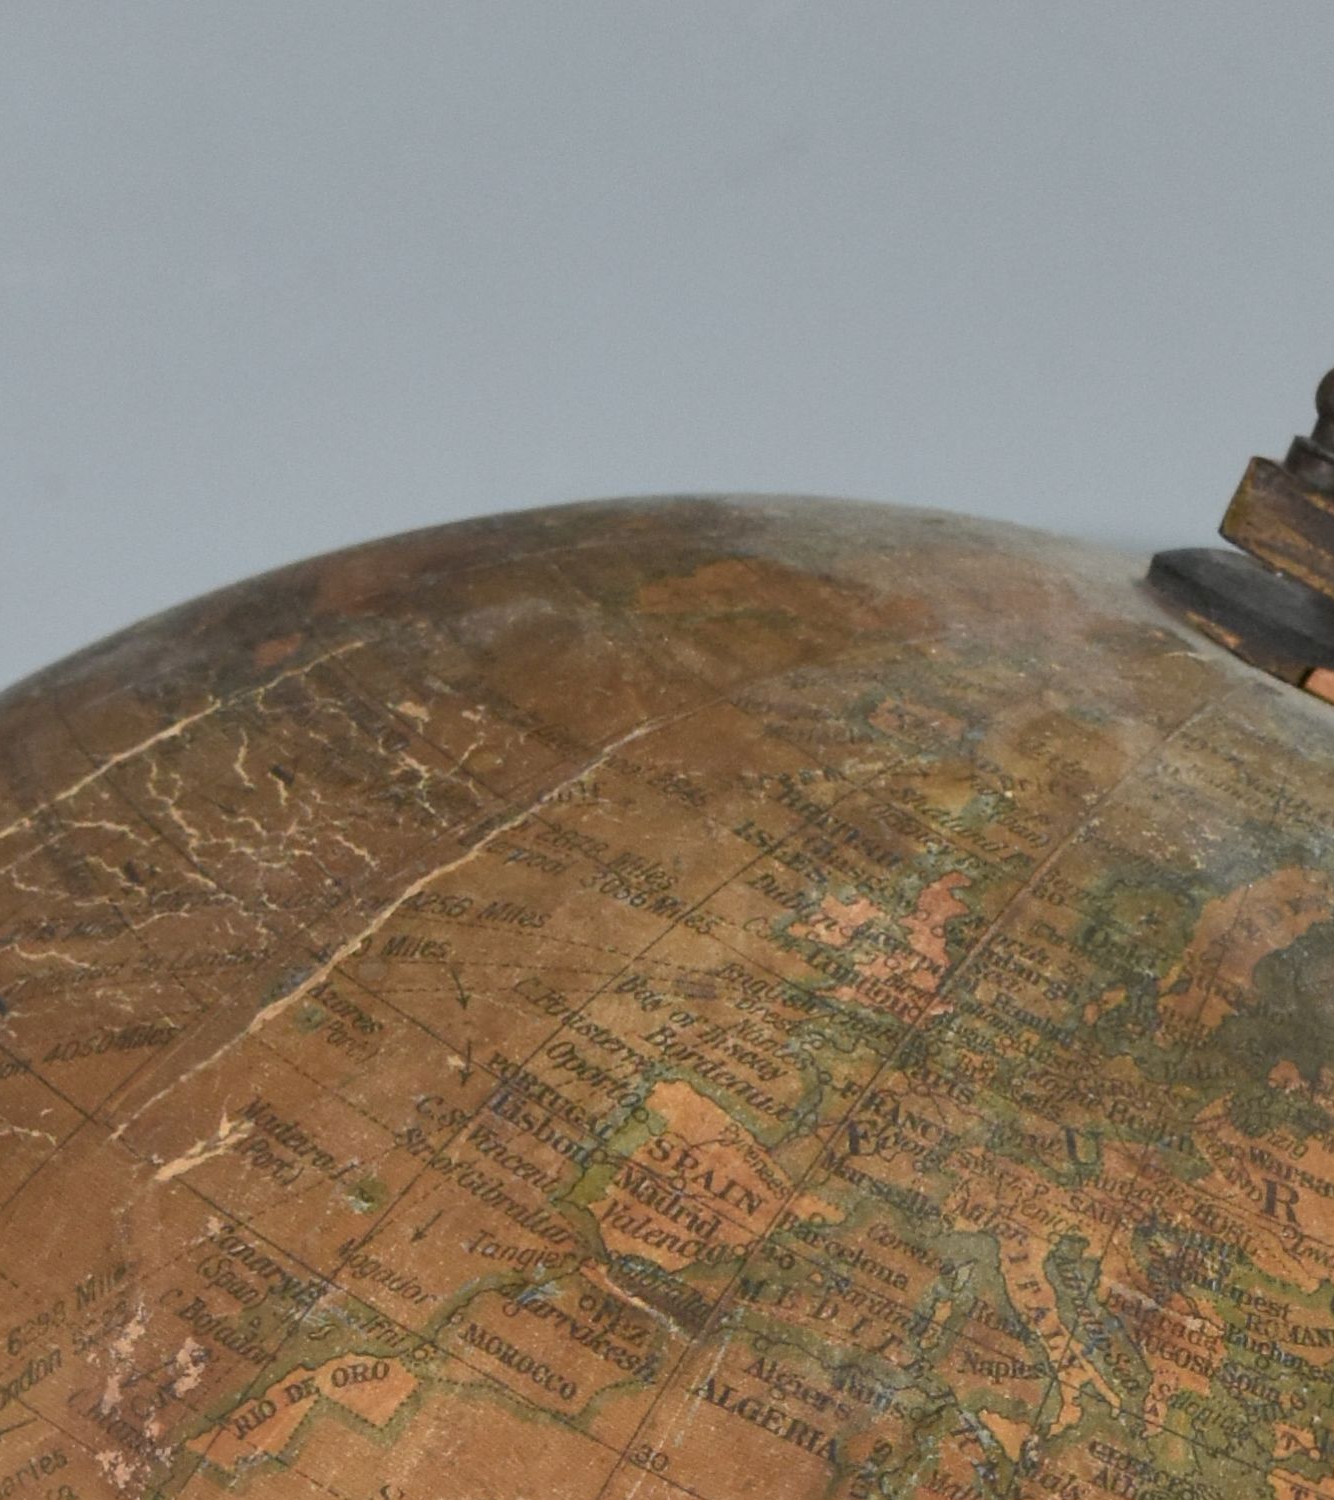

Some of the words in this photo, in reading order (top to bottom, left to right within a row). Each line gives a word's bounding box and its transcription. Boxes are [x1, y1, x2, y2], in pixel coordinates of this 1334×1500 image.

[613, 1167, 723, 1240] Madrid
[646, 1137, 765, 1217] SPAIN
[233, 1399, 278, 1440] RIO
[284, 1376, 322, 1402] DE
[330, 1360, 391, 1389] ORO
[458, 1321, 579, 1400] MOROCCO
[692, 1377, 841, 1465] ALGERIA
